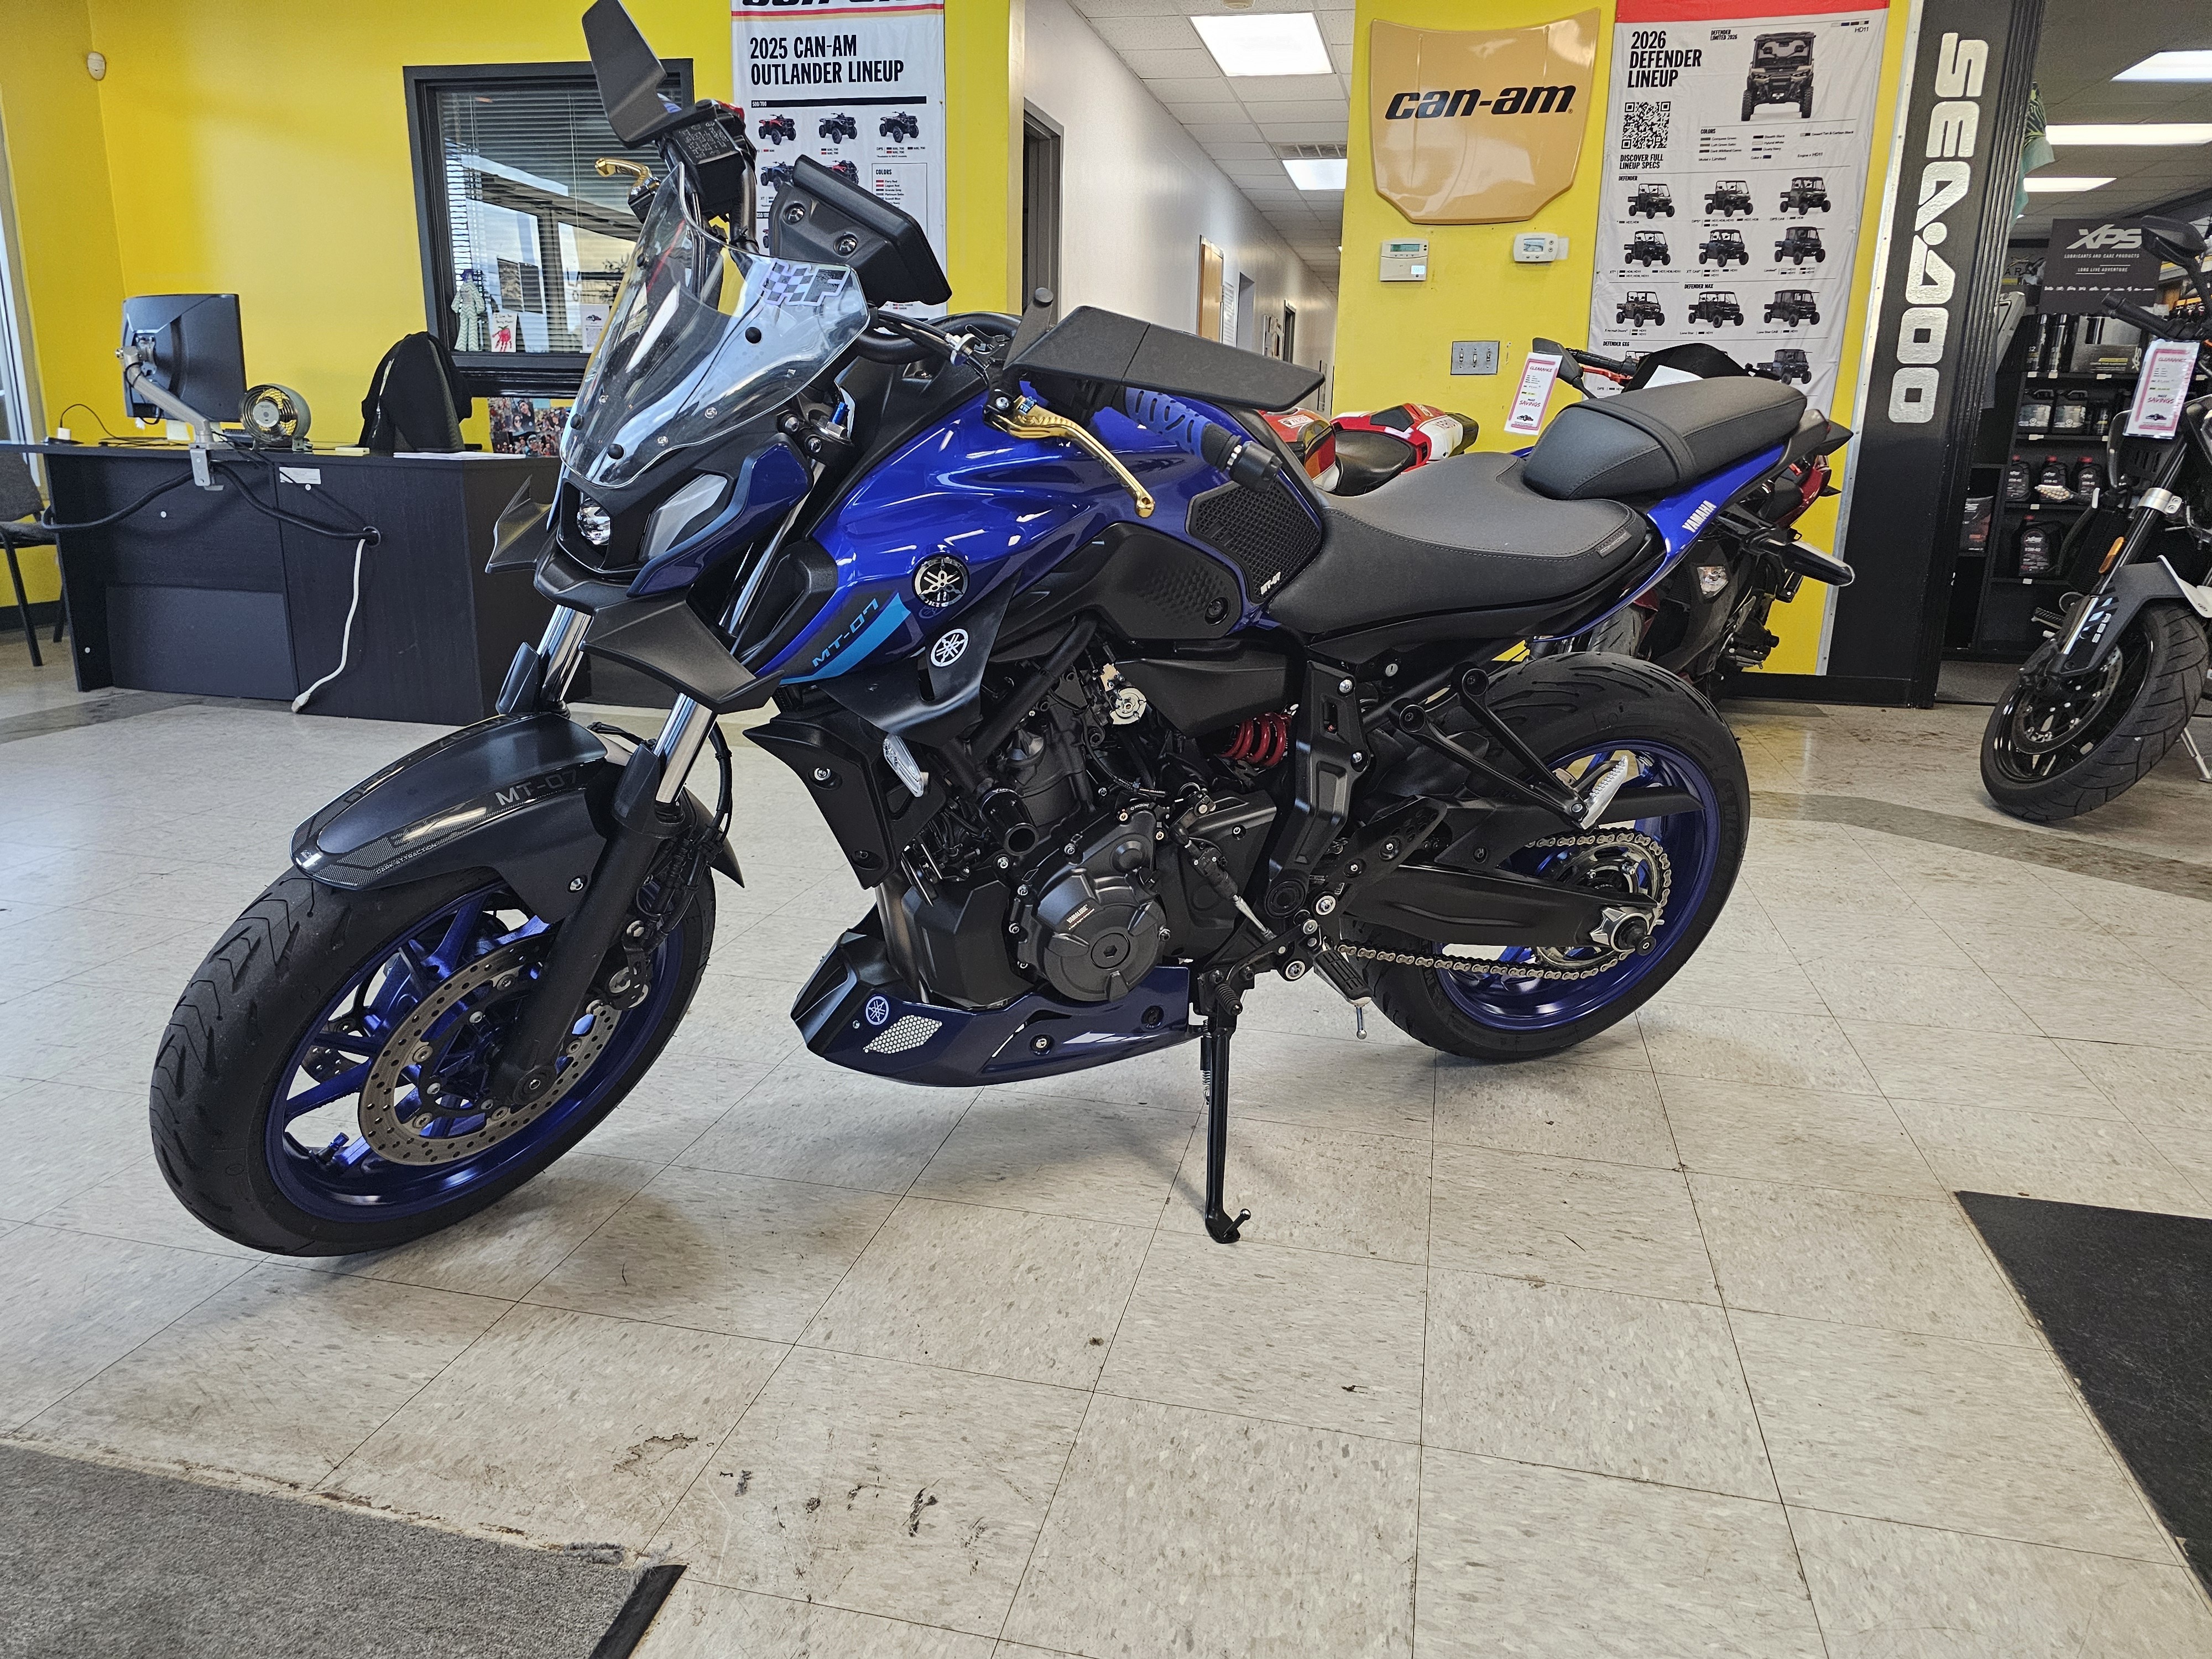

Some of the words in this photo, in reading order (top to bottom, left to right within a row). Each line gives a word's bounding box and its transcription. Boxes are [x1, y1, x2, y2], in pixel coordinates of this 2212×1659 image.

[750, 37, 787, 59] 2025
[794, 34, 857, 58] CAN-AM
[1631, 30, 1666, 49] 2026
[1629, 49, 1702, 69] DEFENDER
[751, 62, 842, 85] OUTLANDER
[848, 60, 904, 82] LINEUP
[1627, 69, 1678, 88] LINEUP
[1385, 85, 1577, 119] can-am
[2065, 224, 2142, 249] XPS
[1682, 500, 1717, 533] YAMAHA
[1260, 571, 1282, 595] MT-07
[811, 598, 879, 667] MT-07
[495, 769, 577, 806] MT-07
[376, 863, 394, 874] DARK
[396, 843, 437, 864] ATTRACTION
[1067, 904, 1088, 924] YAMALUBE
